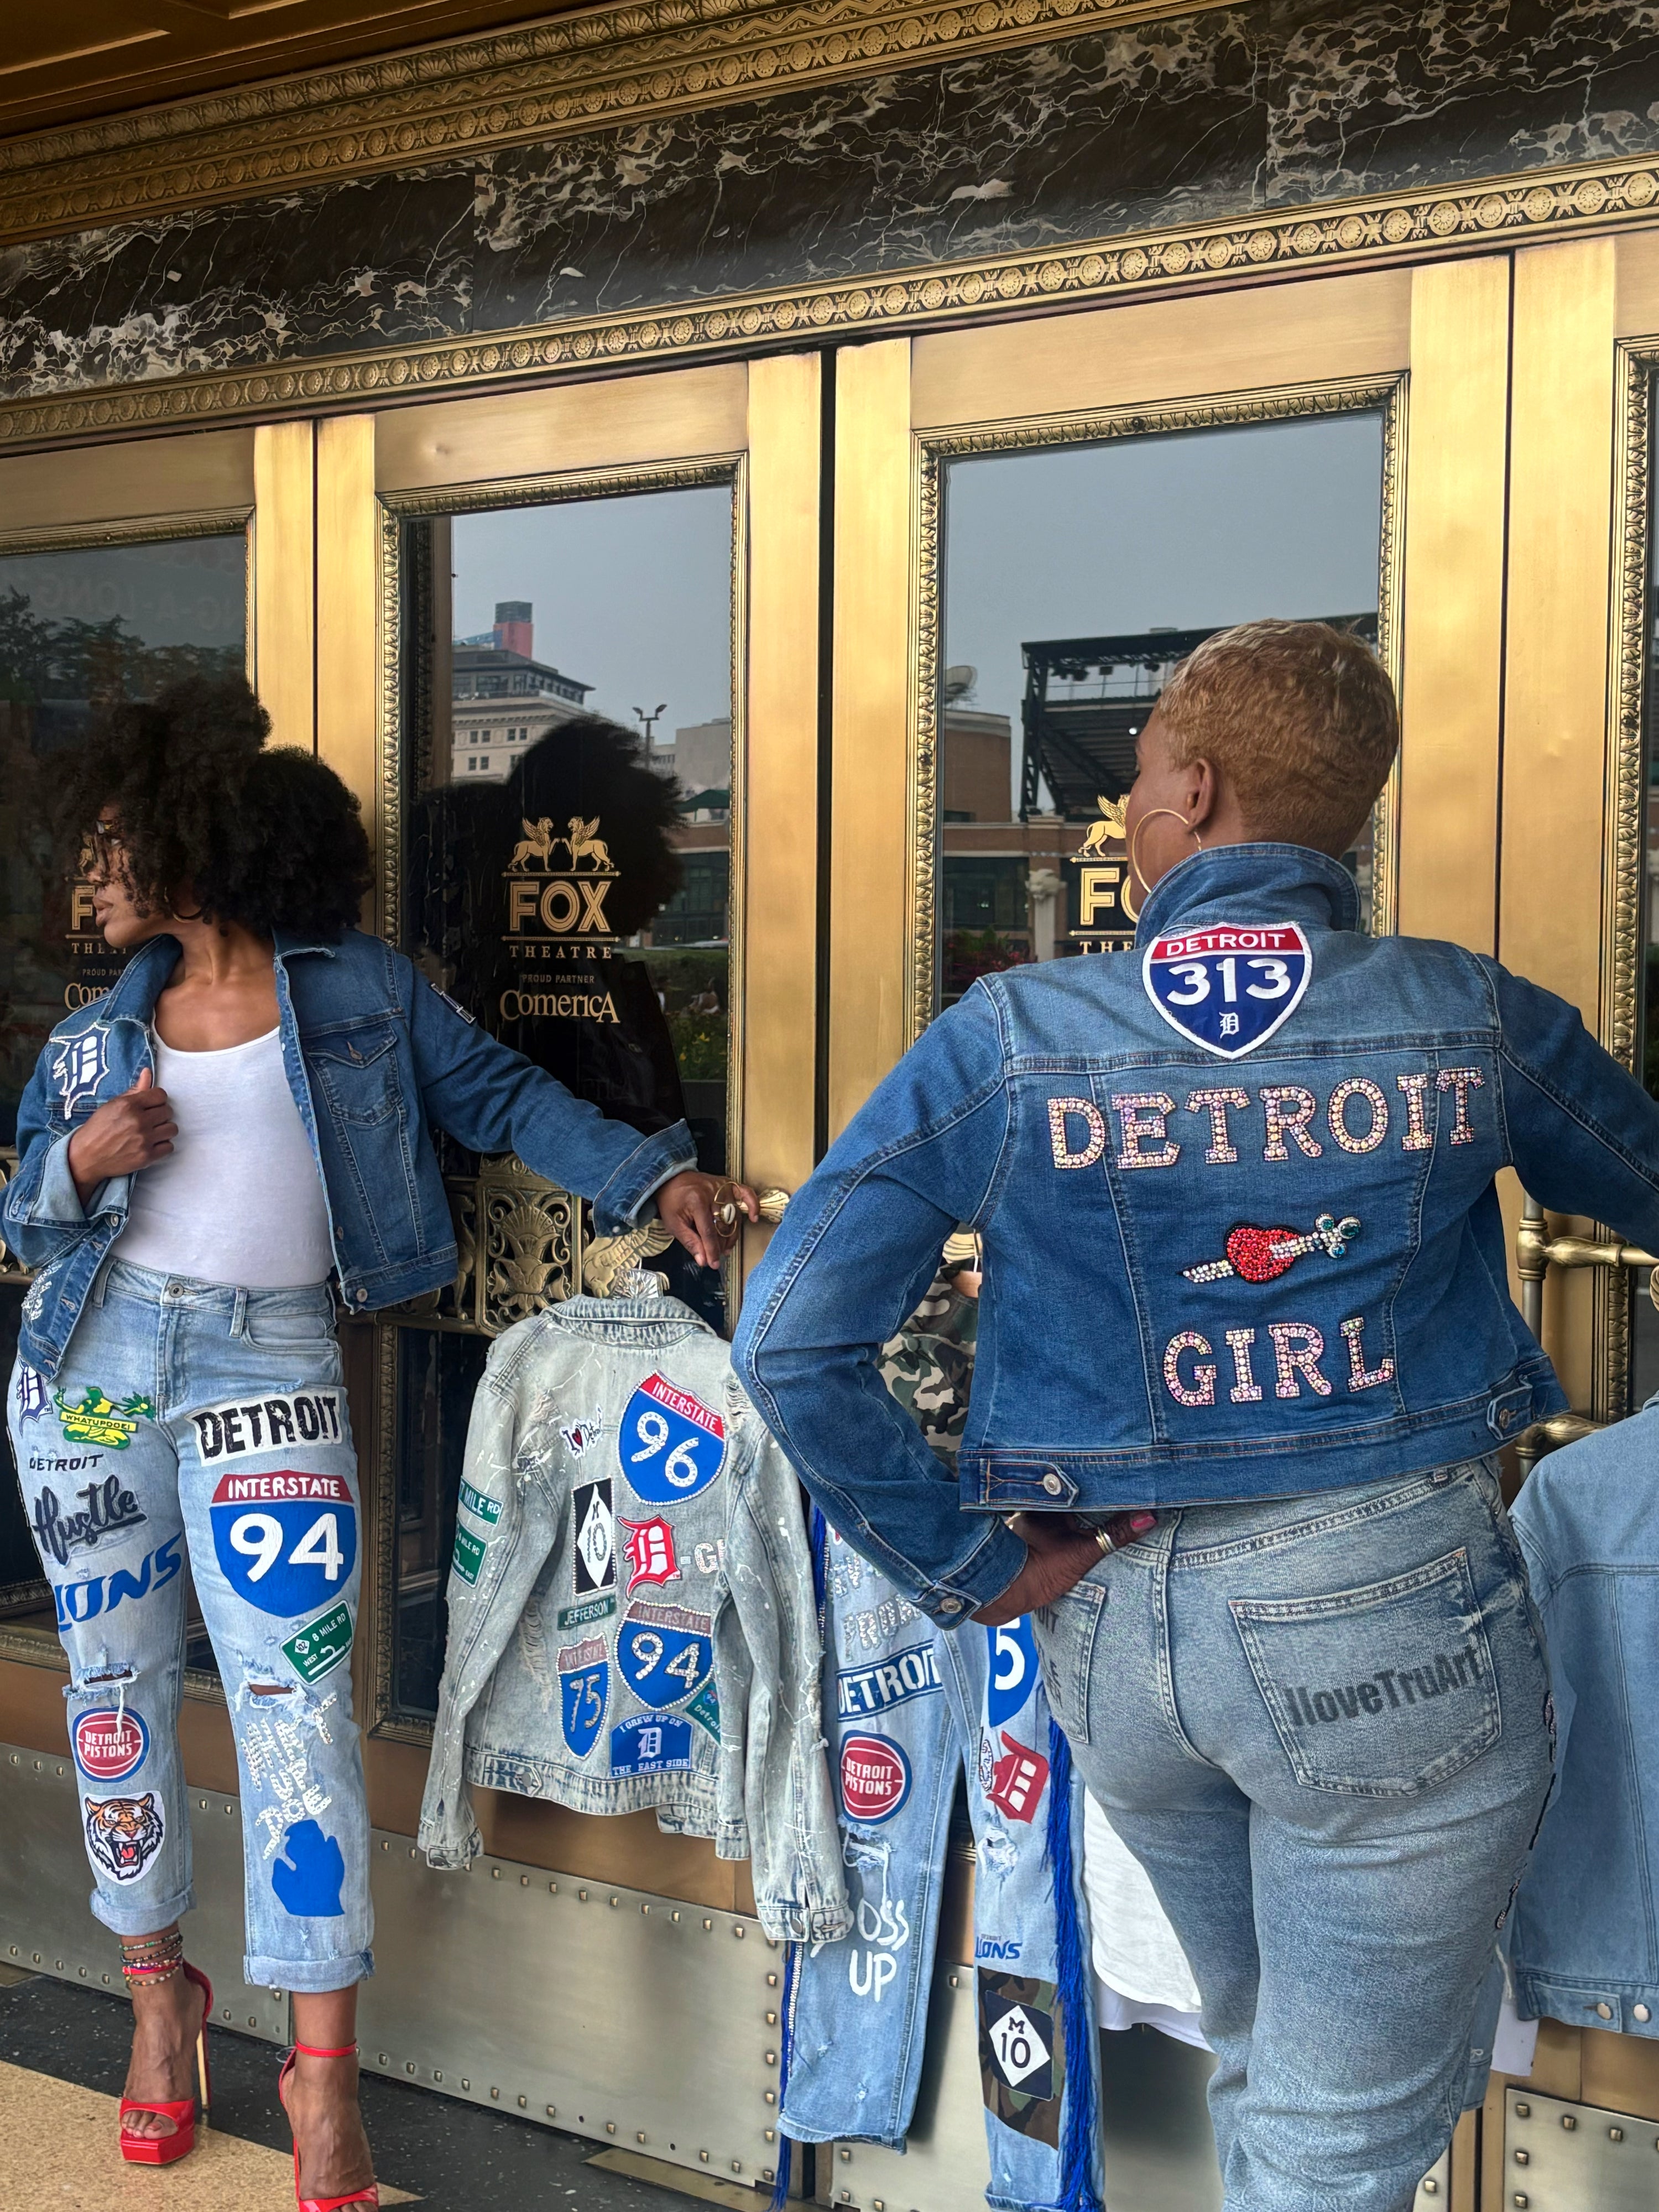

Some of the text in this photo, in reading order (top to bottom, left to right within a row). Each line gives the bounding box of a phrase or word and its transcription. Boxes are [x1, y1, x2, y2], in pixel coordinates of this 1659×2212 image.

[509, 880, 612, 933] FOX
[509, 945, 612, 959] THEATRE
[1166, 932, 1286, 956] DETROIT
[82, 968, 106, 977] PROUD
[522, 974, 595, 984] PROUD PARTNER
[1167, 957, 1291, 1006] 313
[1046, 1066, 1485, 1170] DETROIT
[1163, 1317, 1394, 1406] GIRL
[651, 1381, 718, 1431] INTERSTATE
[191, 1395, 338, 1459] DETROIT
[29, 1454, 104, 1472] DETROIT
[631, 1411, 699, 1488] 96
[228, 1477, 341, 1499] INTERSTATE
[464, 1487, 486, 1516] MILE
[487, 1503, 500, 1515] RD
[32, 1474, 148, 1566] Hustle
[229, 1513, 345, 1582] 94
[587, 1522, 607, 1563] 10
[55, 1531, 182, 1632] IONS
[312, 1613, 347, 1642] 8 MILE RD
[564, 1600, 609, 1626] JEFFERSON
[638, 1605, 708, 1630] INTERSTATE
[302, 1653, 318, 1667] WEST
[632, 1631, 700, 1689] 94
[570, 1673, 601, 1733] 75
[655, 1715, 668, 1723] UP
[84, 1742, 132, 1757] PISTONS
[85, 1730, 132, 1746] DETROIT
[612, 1757, 690, 1776] THE EAST SIDE
[846, 1756, 894, 1779] DETROIT
[845, 1771, 893, 1796] PISTONS
[858, 1898, 910, 1951] OSS
[849, 1949, 897, 2003] UP
[1009, 2017, 1025, 2034] M
[1001, 2032, 1031, 2068] 10
